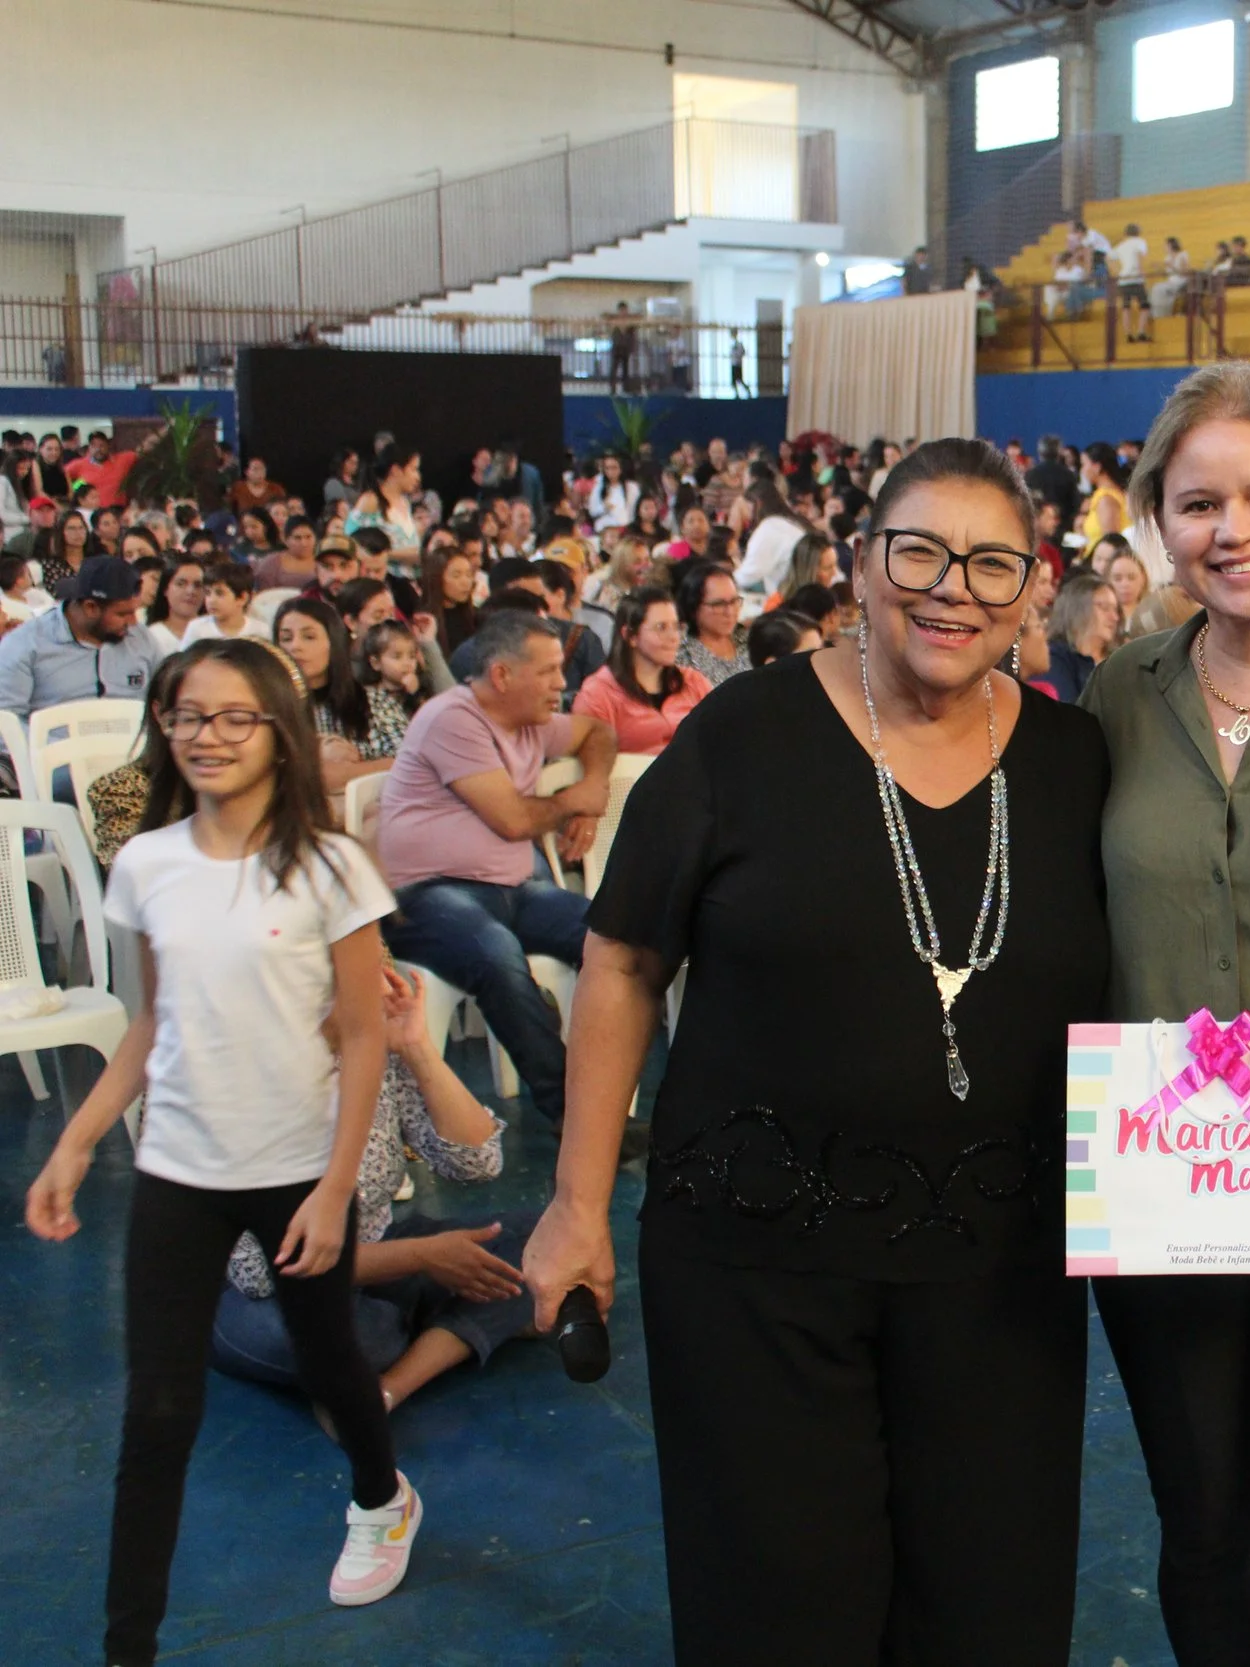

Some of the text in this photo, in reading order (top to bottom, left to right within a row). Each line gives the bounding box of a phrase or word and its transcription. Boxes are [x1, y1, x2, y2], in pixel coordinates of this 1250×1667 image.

[1166, 1243, 1201, 1253] Enxoval
[1169, 1255, 1194, 1264] Moda
[1196, 1255, 1218, 1264] Bebê
